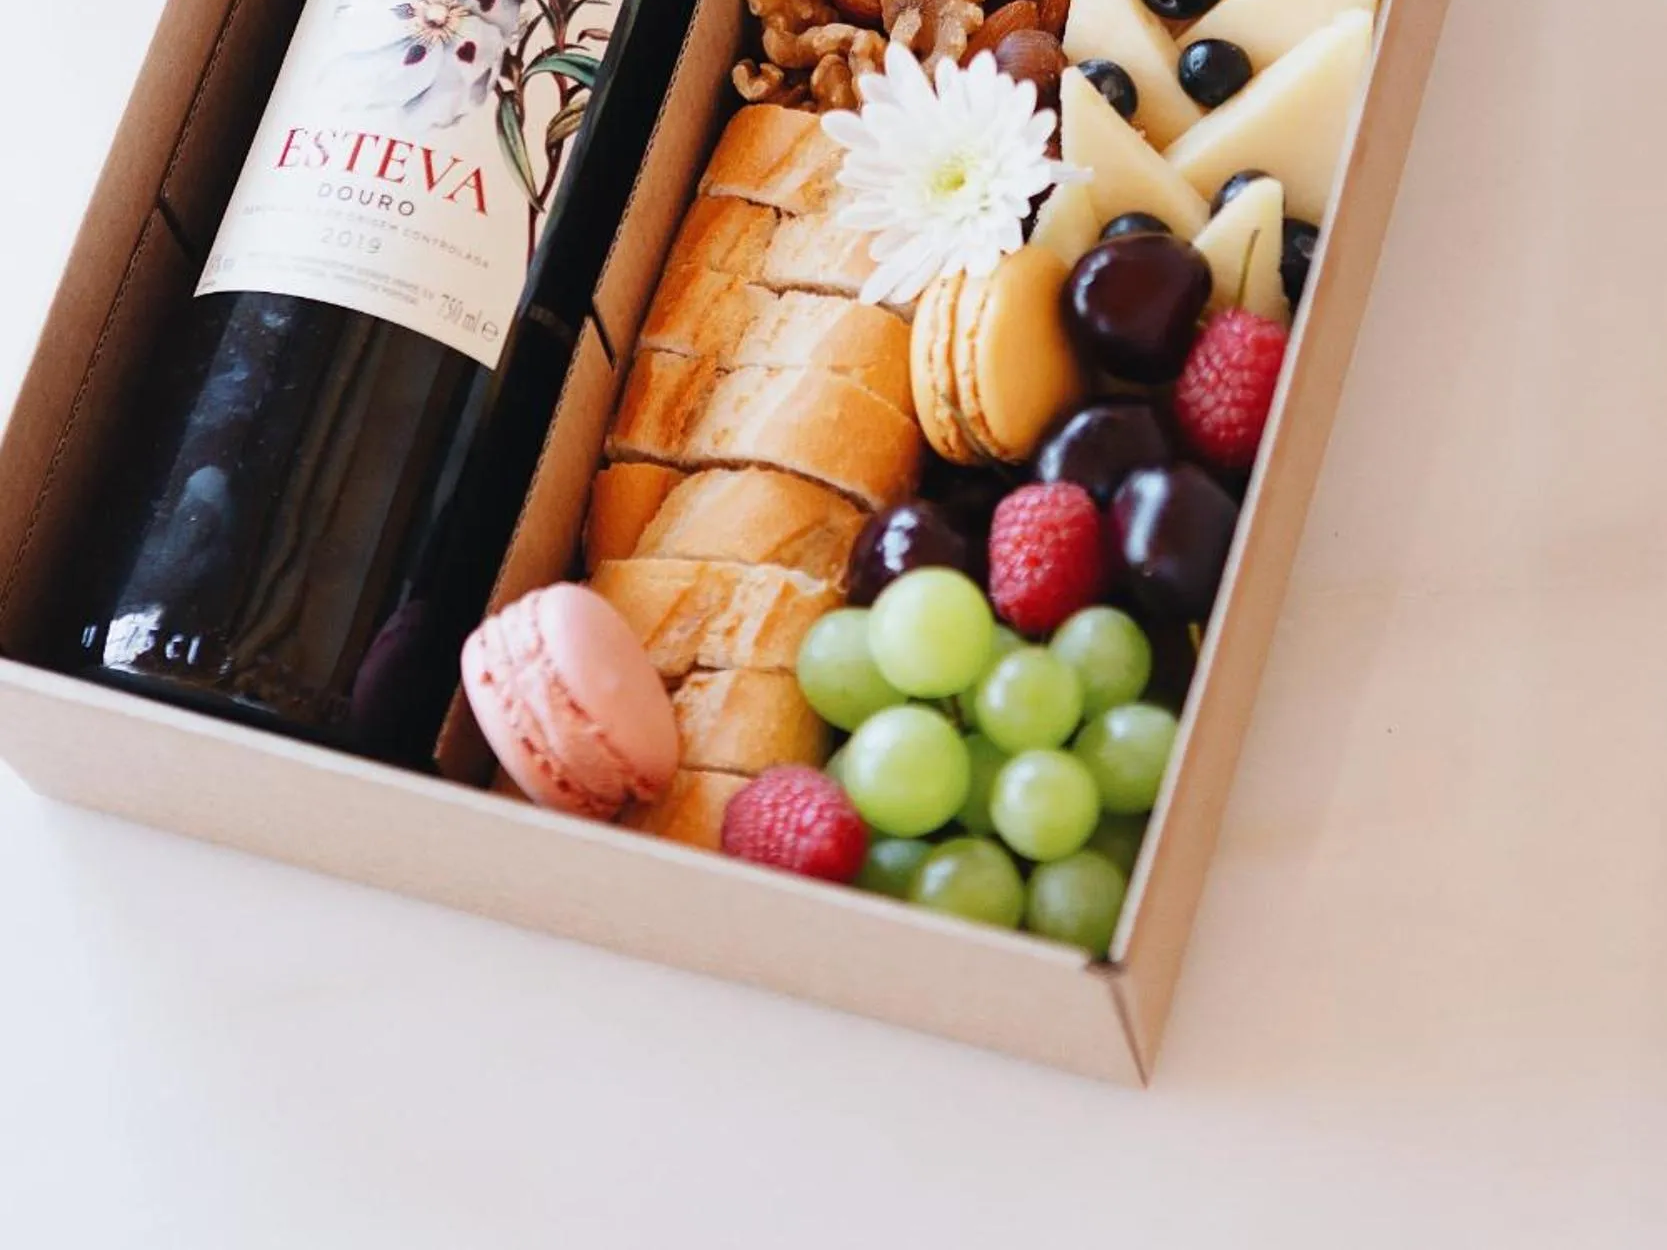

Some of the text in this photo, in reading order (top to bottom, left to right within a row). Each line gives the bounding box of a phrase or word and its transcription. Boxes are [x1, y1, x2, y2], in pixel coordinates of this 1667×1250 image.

[277, 128, 487, 216] ESTEVA
[317, 181, 416, 217] DOURO
[319, 226, 382, 254] 2019
